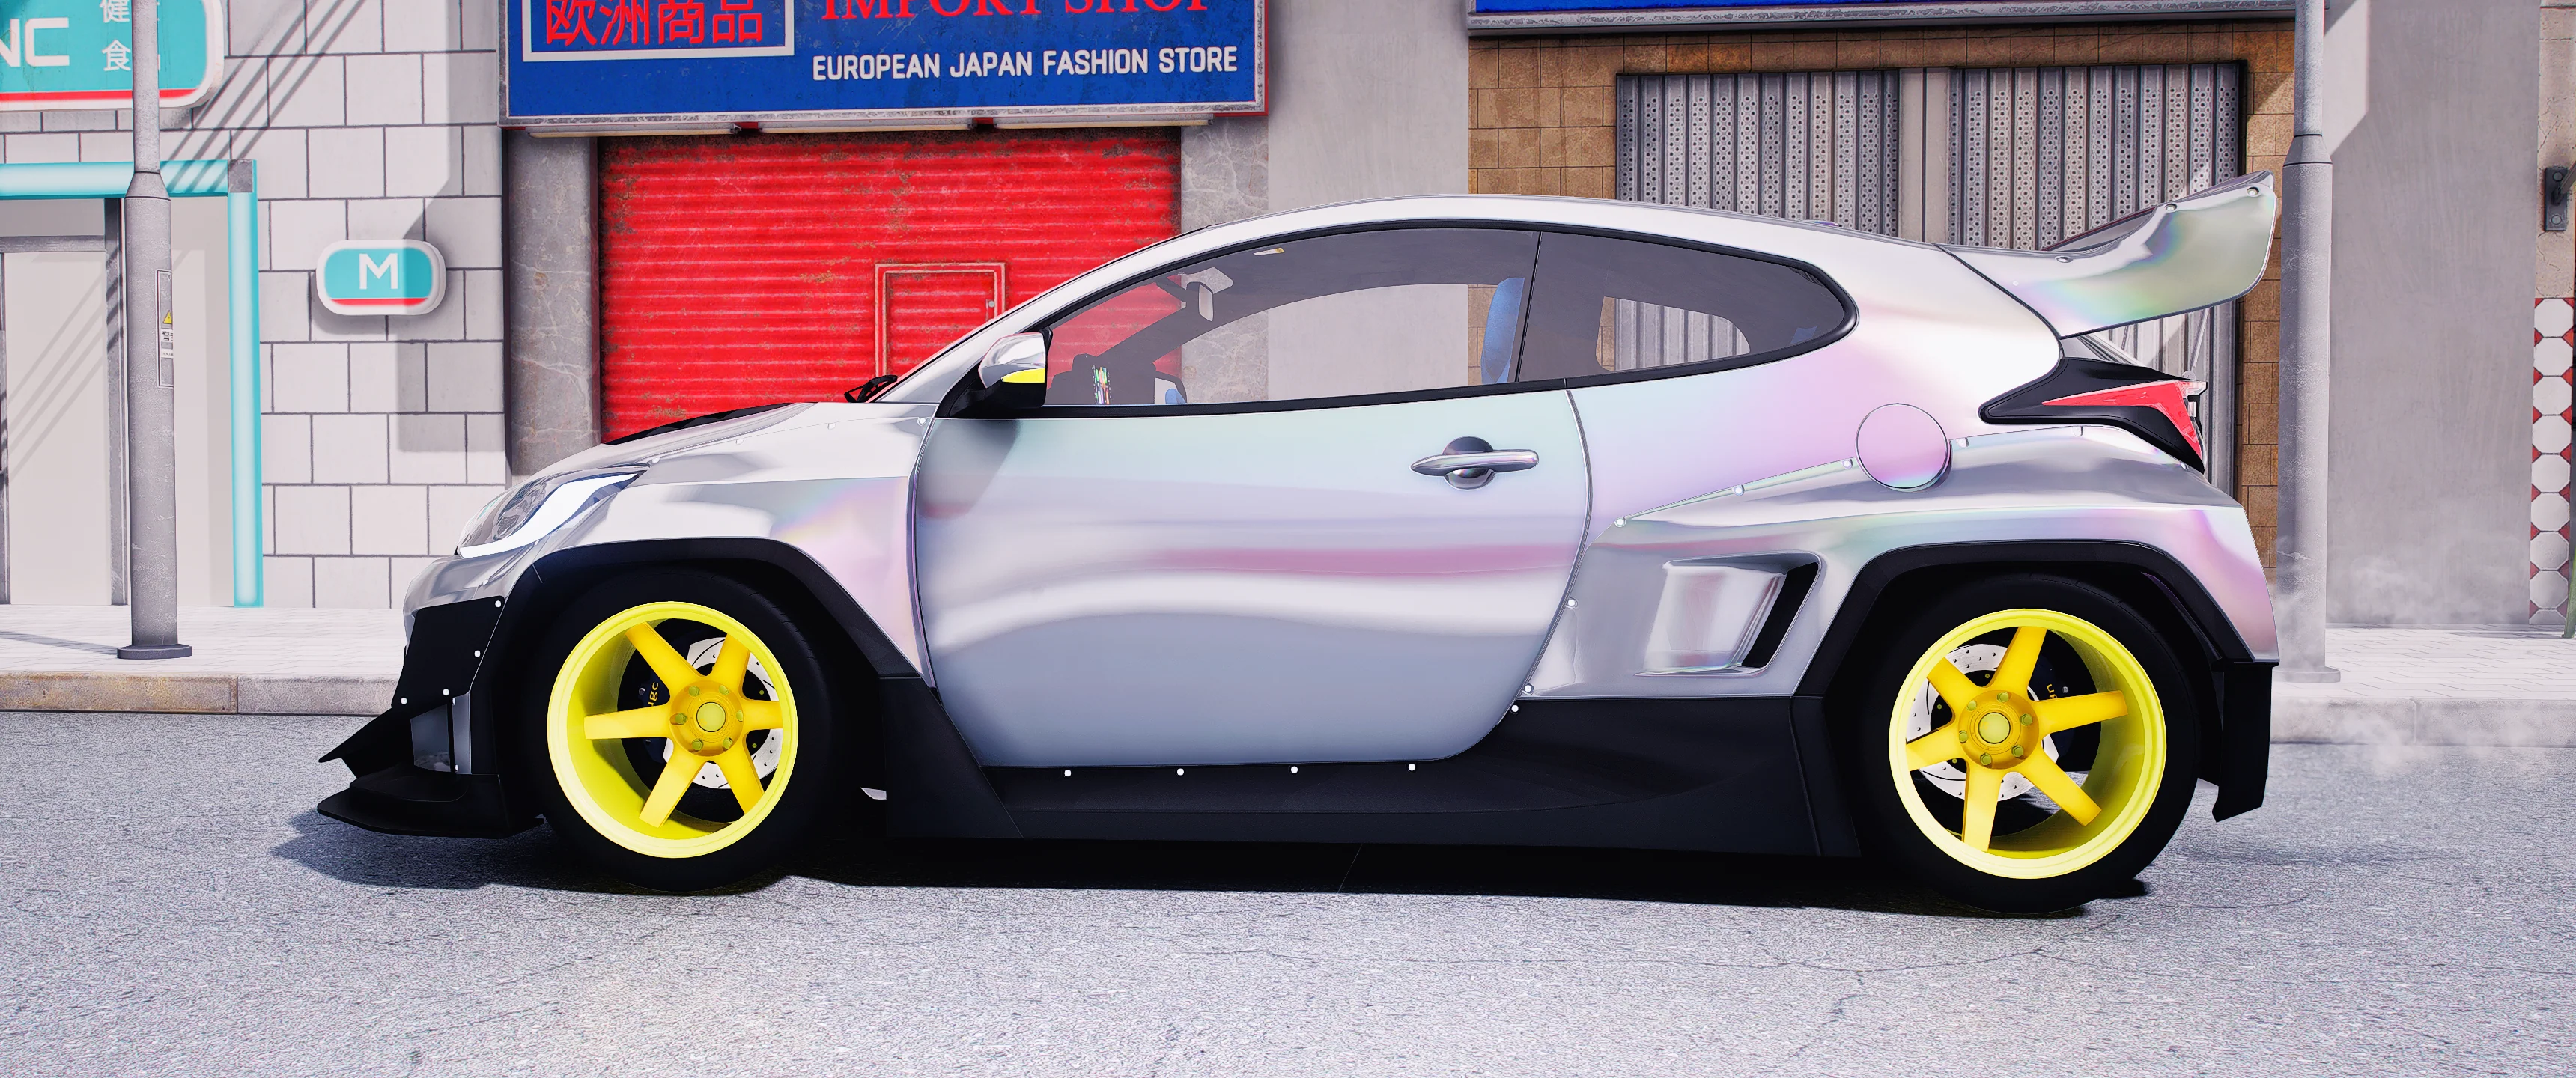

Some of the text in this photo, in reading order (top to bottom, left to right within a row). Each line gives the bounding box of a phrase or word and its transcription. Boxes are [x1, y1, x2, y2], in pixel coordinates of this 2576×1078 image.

[546, 0, 762, 46] 欧洲商品
[812, 46, 1237, 80] EUROPEAN JAPAN FASHION STORE
[359, 253, 398, 290] M
